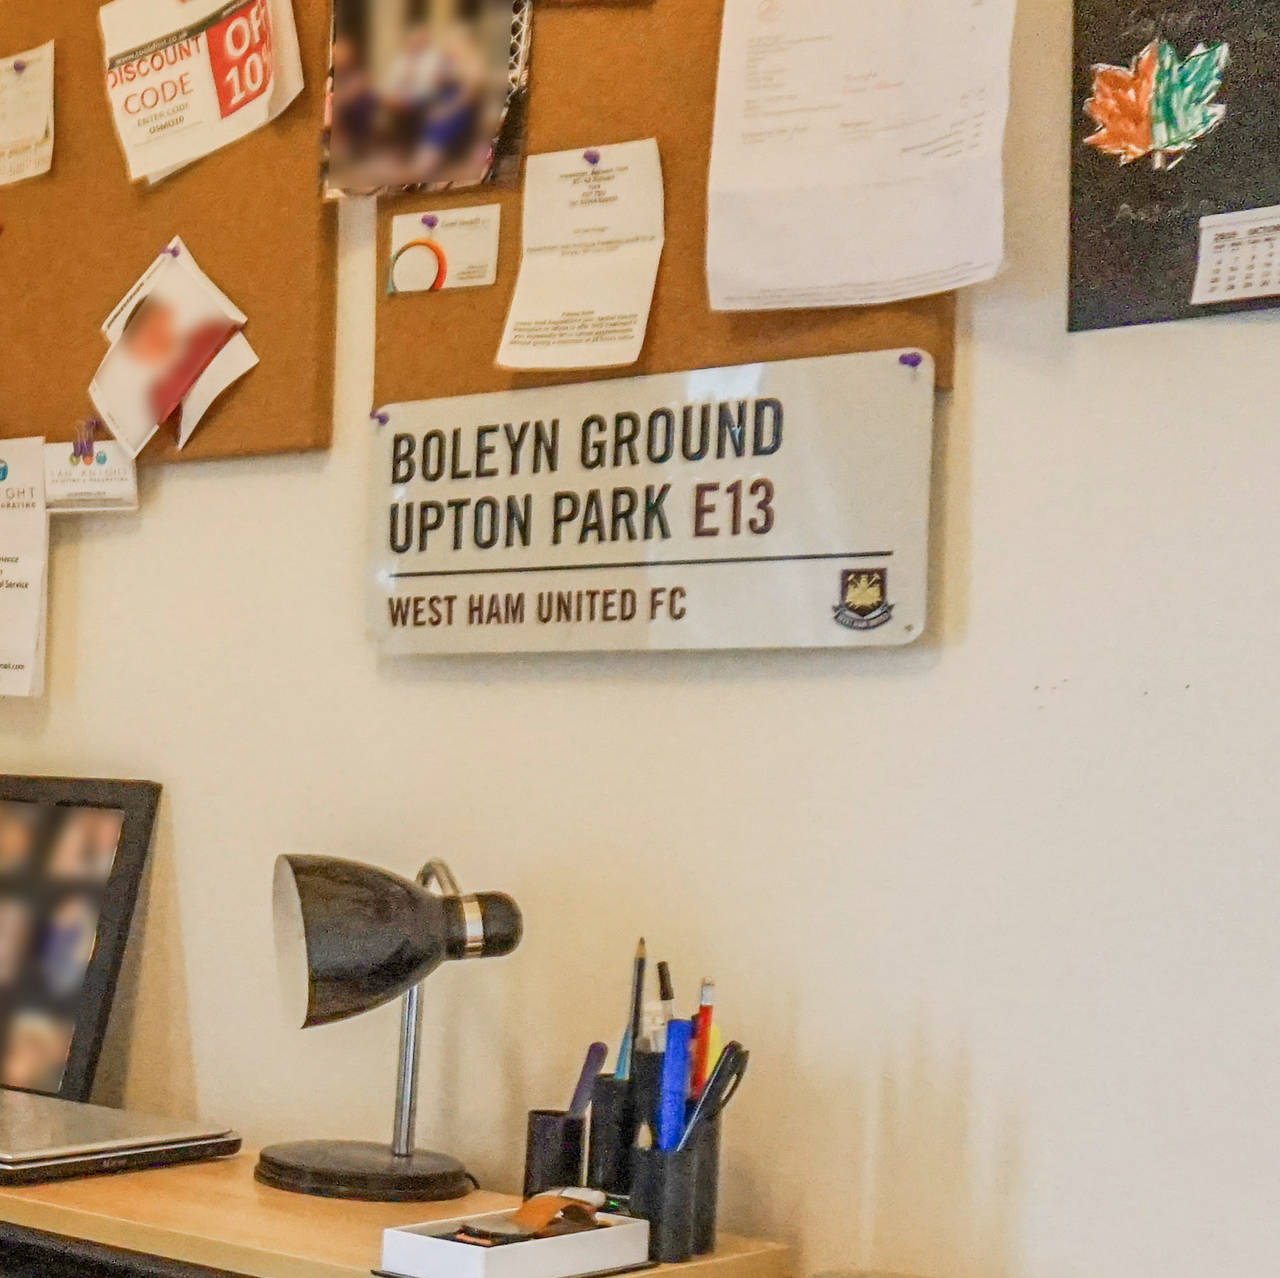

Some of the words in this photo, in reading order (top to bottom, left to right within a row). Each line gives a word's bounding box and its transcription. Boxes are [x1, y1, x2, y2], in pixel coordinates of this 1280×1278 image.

[105, 35, 203, 89] DISCOUNT
[123, 72, 194, 115] CODE
[390, 418, 562, 485] BOLEYN
[580, 397, 783, 471] GROUND
[388, 493, 533, 554] UPTON
[551, 482, 673, 545] PARK
[693, 477, 777, 537] E13
[5, 580, 30, 589] Service
[388, 593, 458, 628] WEST
[468, 590, 526, 625] HAM
[538, 587, 638, 623] UNITED
[650, 585, 688, 621] FC
